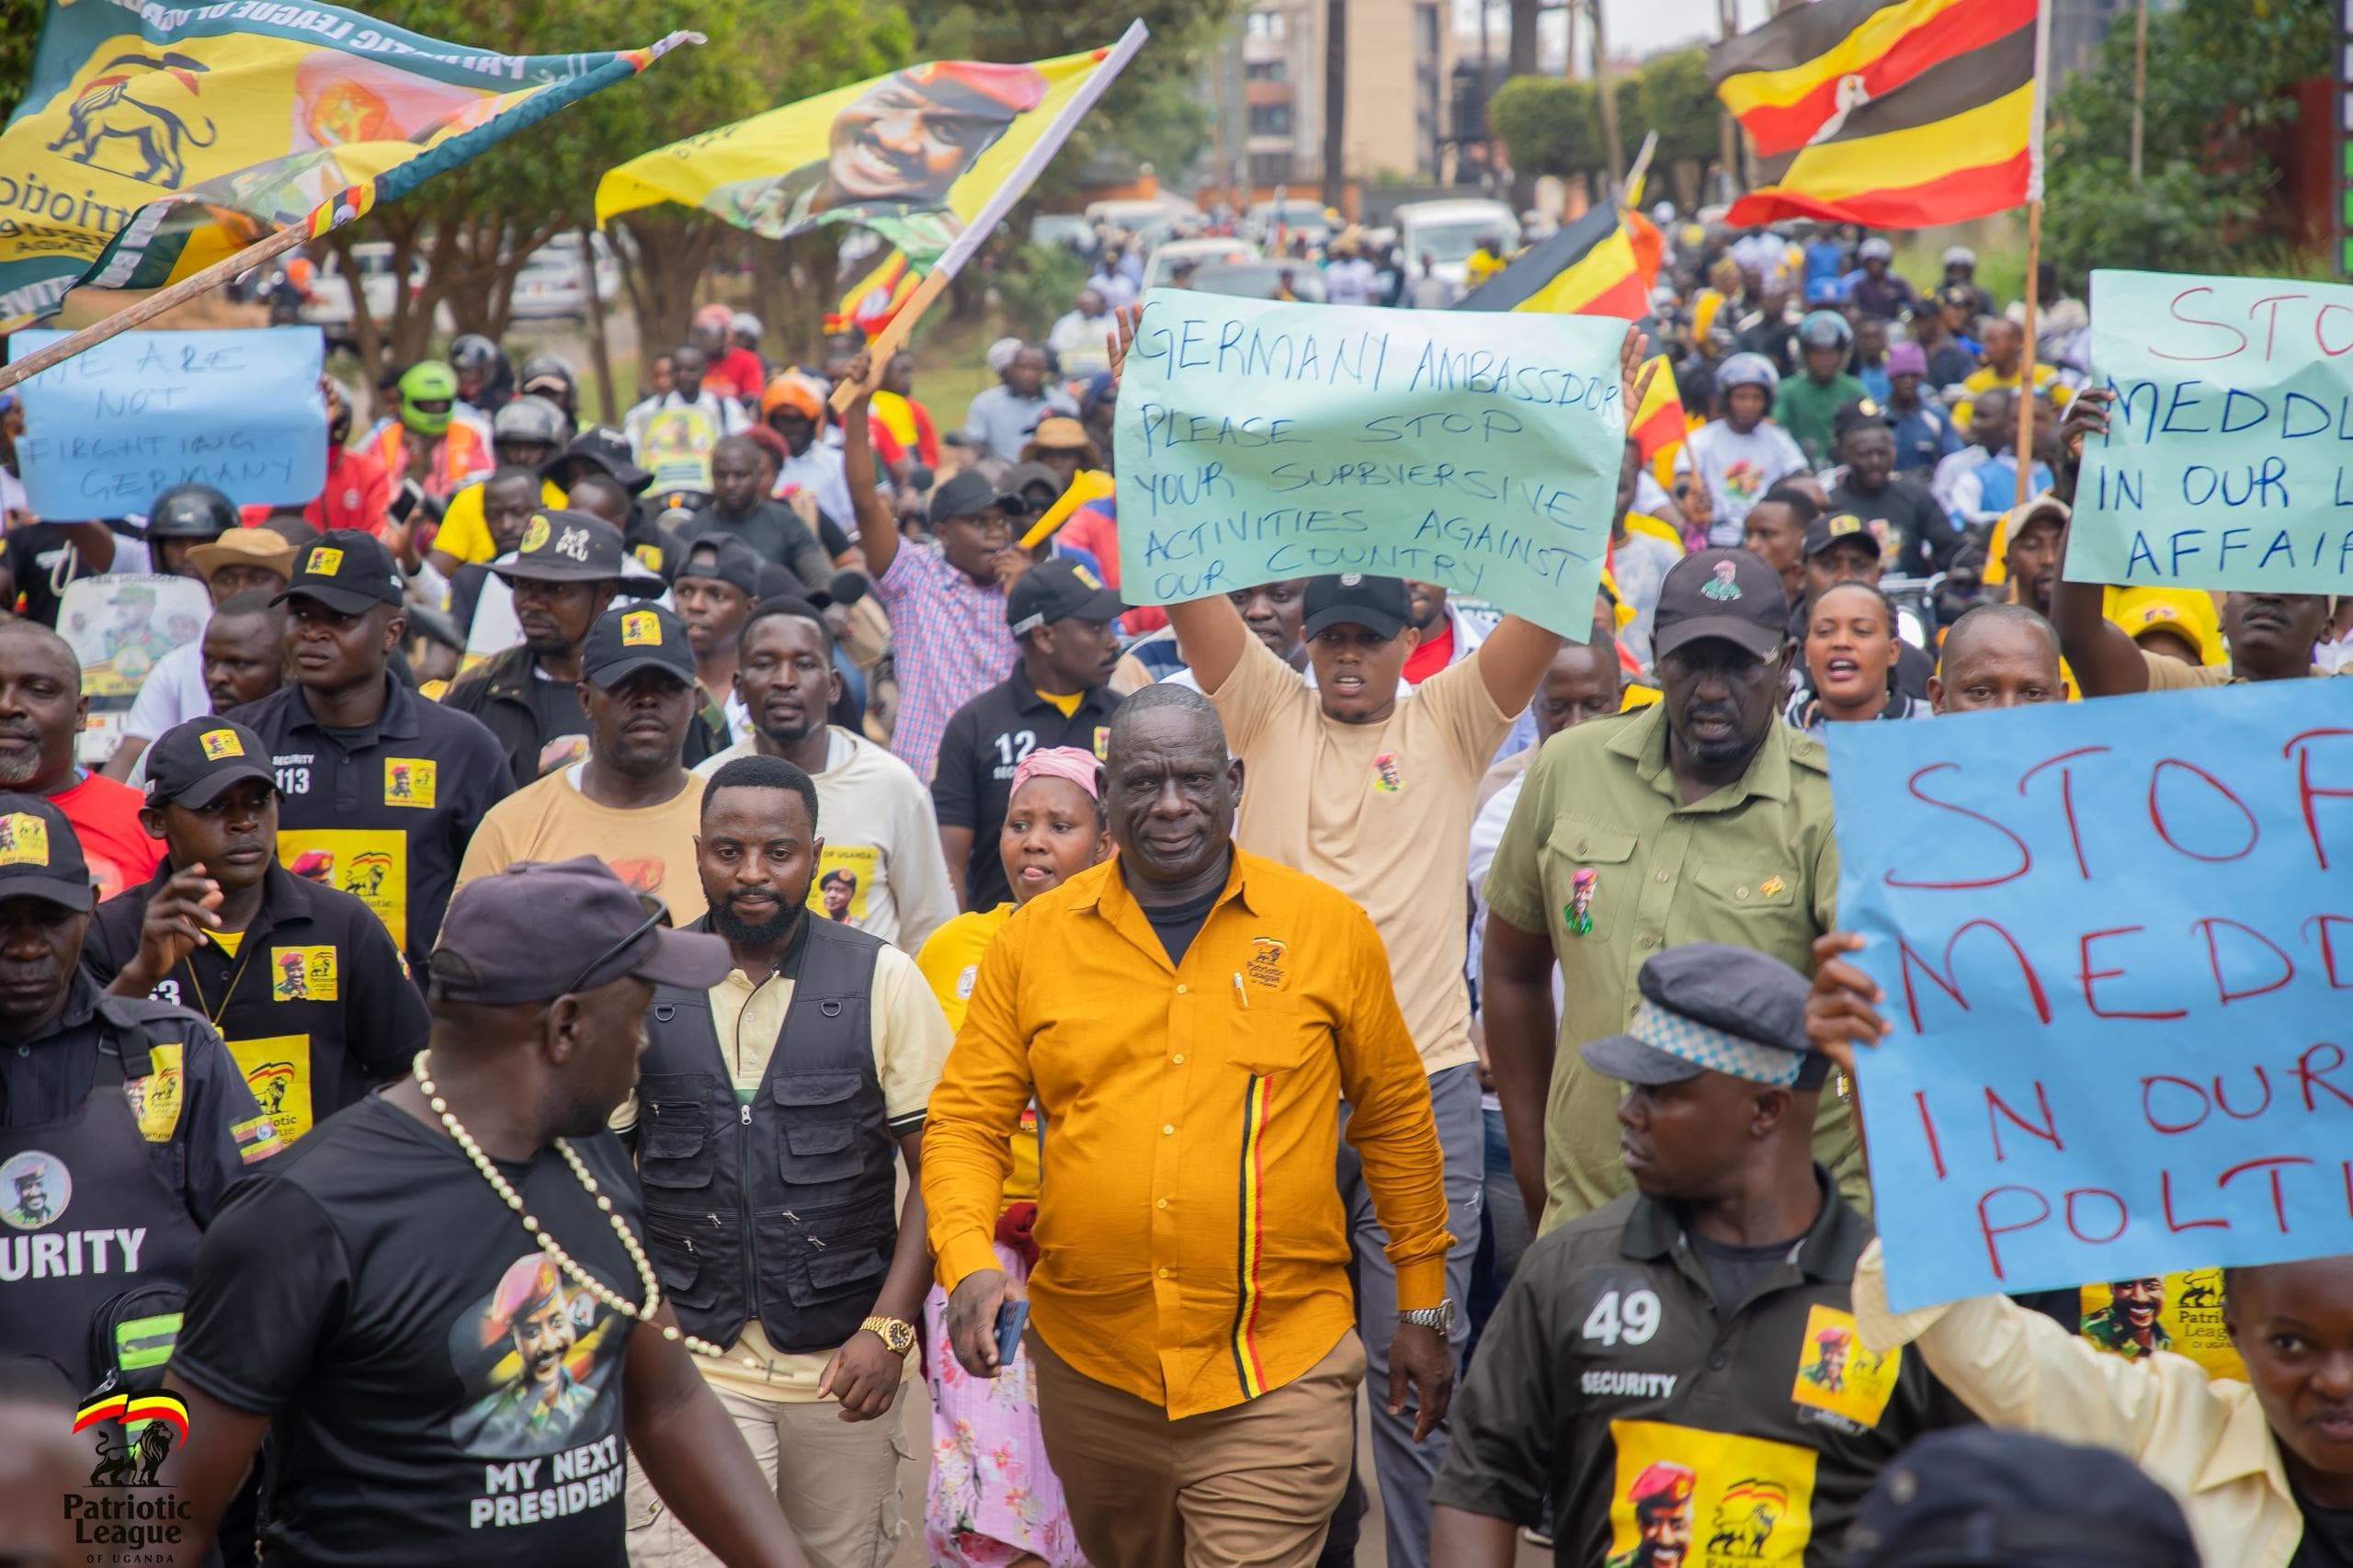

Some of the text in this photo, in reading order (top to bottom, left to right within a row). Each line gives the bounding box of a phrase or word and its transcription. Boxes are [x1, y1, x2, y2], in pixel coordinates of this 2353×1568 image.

[139, 341, 248, 373] ARE
[1135, 301, 1620, 415] GERMANY AMBASSDOR
[95, 386, 189, 420] NOT
[1142, 403, 1522, 458] PLEASE STOP
[80, 458, 294, 503] GERMANY
[1135, 461, 1234, 517] YOUR
[2097, 463, 2143, 511] IN
[2182, 456, 2290, 508] OUR
[1145, 508, 1590, 586] ACTIVITIES AGAINST
[1154, 542, 1485, 599] OUR COUNTRY
[272, 754, 315, 767] SECURITY
[995, 729, 1037, 765] 12
[274, 767, 311, 795] 113
[1915, 1042, 2353, 1180] IN OUR
[1582, 1289, 1663, 1346] 49
[2178, 1311, 2221, 1324] Patri
[2184, 1324, 2228, 1341] Leag
[1582, 1369, 1678, 1398] SECURITY
[485, 1434, 619, 1495] MY NEXT
[470, 1464, 624, 1529] PRESIDENT
